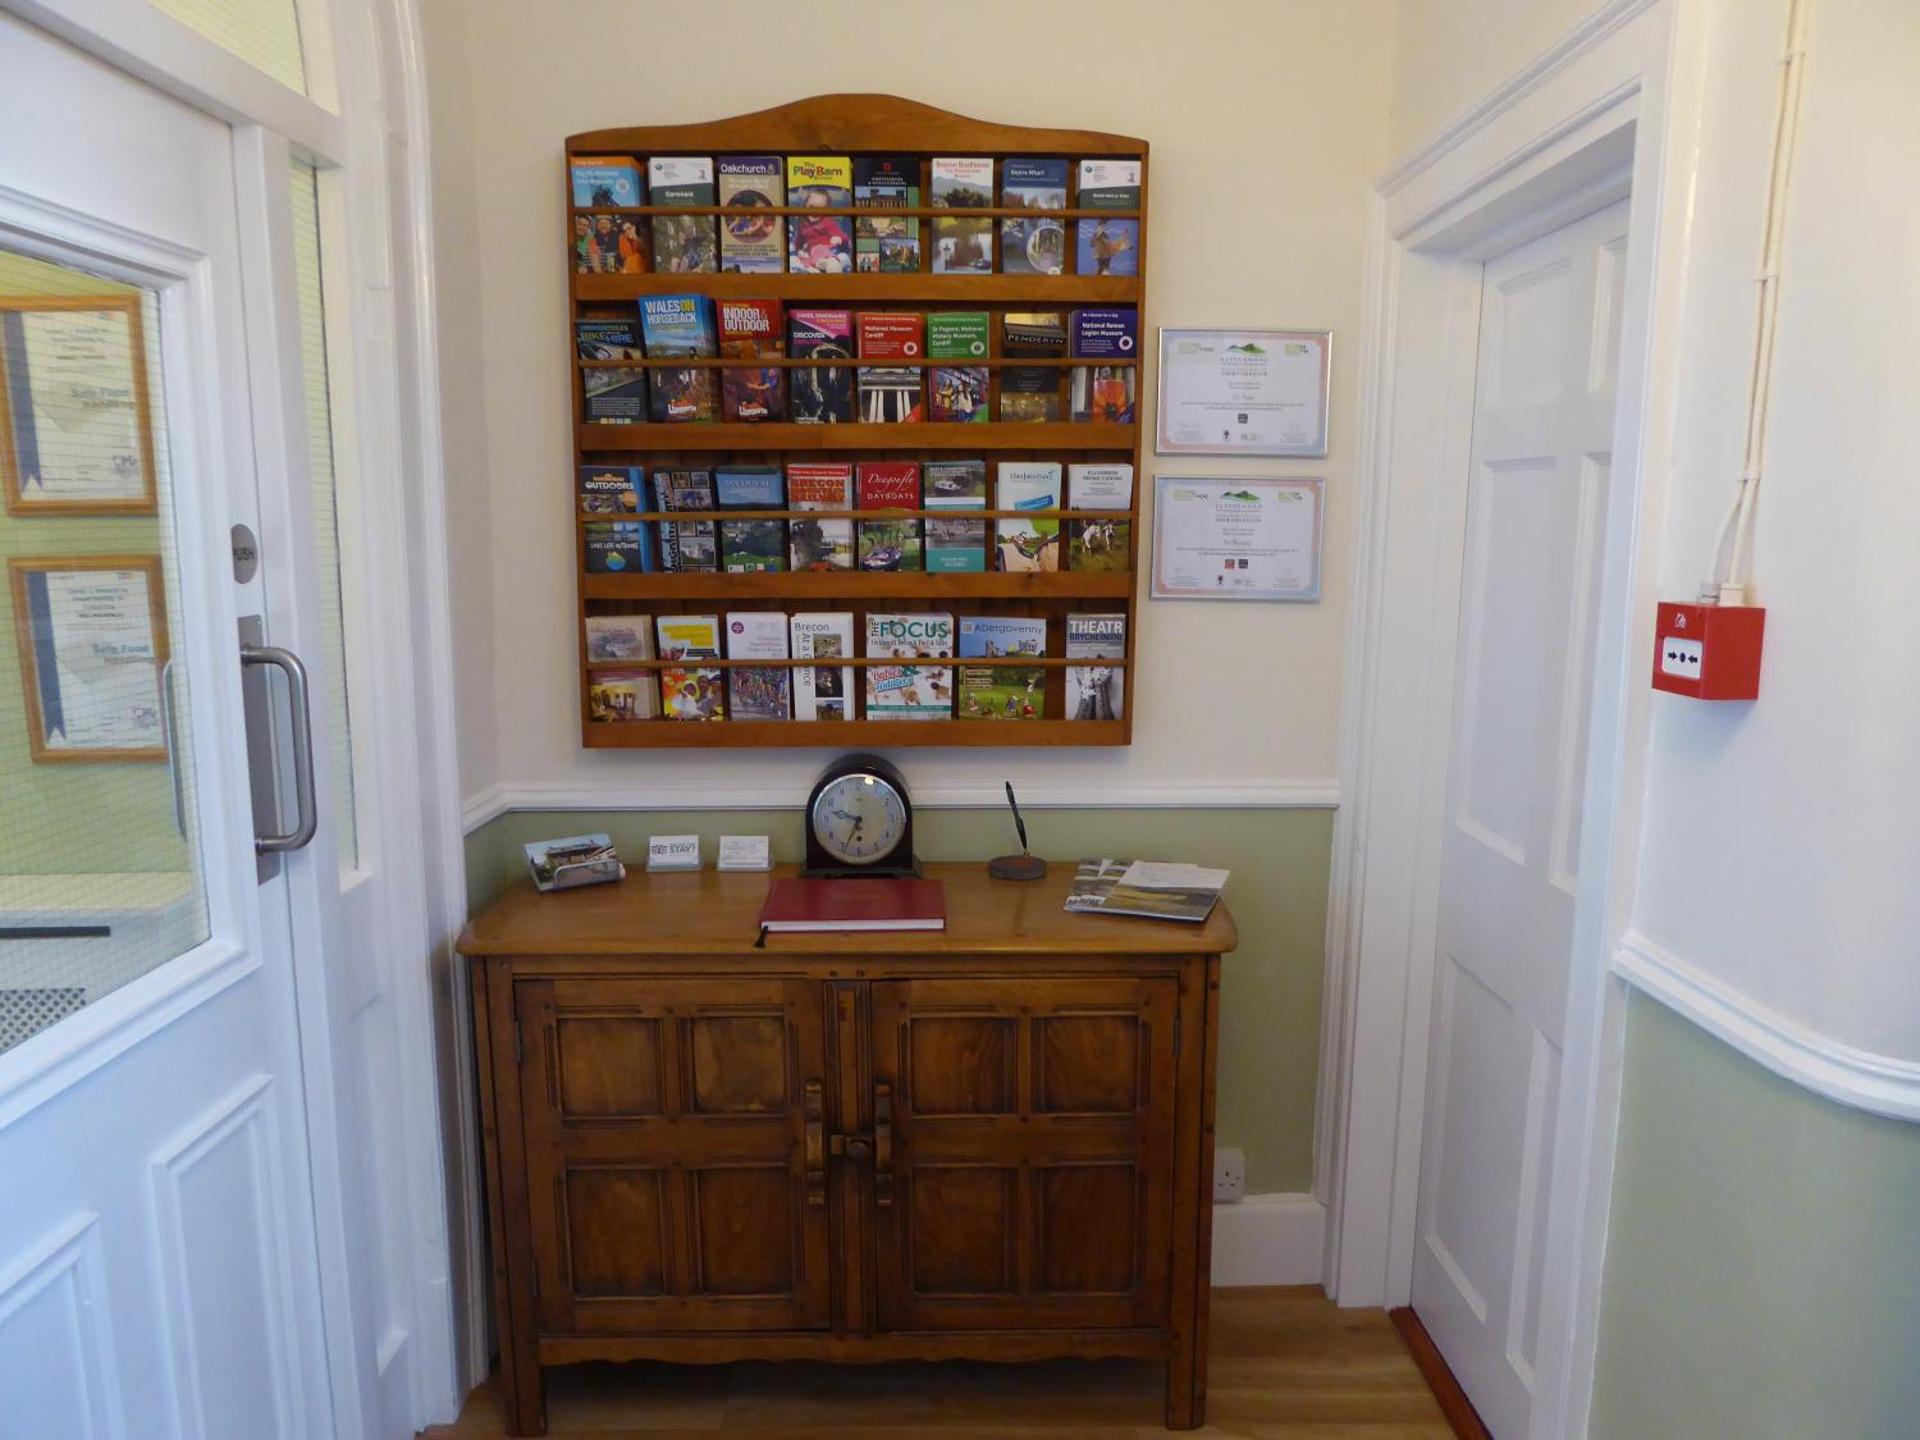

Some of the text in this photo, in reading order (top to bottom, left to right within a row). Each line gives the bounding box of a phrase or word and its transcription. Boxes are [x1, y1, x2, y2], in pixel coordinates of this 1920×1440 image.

[720, 163, 767, 175] Oakchurch
[645, 299, 695, 313] WALES ON
[647, 312, 697, 325] HORSEBACK
[723, 307, 760, 320] INDOOR
[725, 319, 770, 332] OUTDOOR
[864, 331, 884, 339] Cardiff
[1007, 334, 1064, 345] PENDERYN
[1081, 330, 1100, 338] Legion
[585, 482, 634, 490] OUTDOORS
[867, 491, 915, 500] DAYBOATS
[794, 622, 830, 632] Brecon
[871, 618, 880, 637] THE
[880, 620, 949, 638] FOCUS
[974, 623, 1044, 635] Abergavenny
[1069, 620, 1123, 634] THEATR
